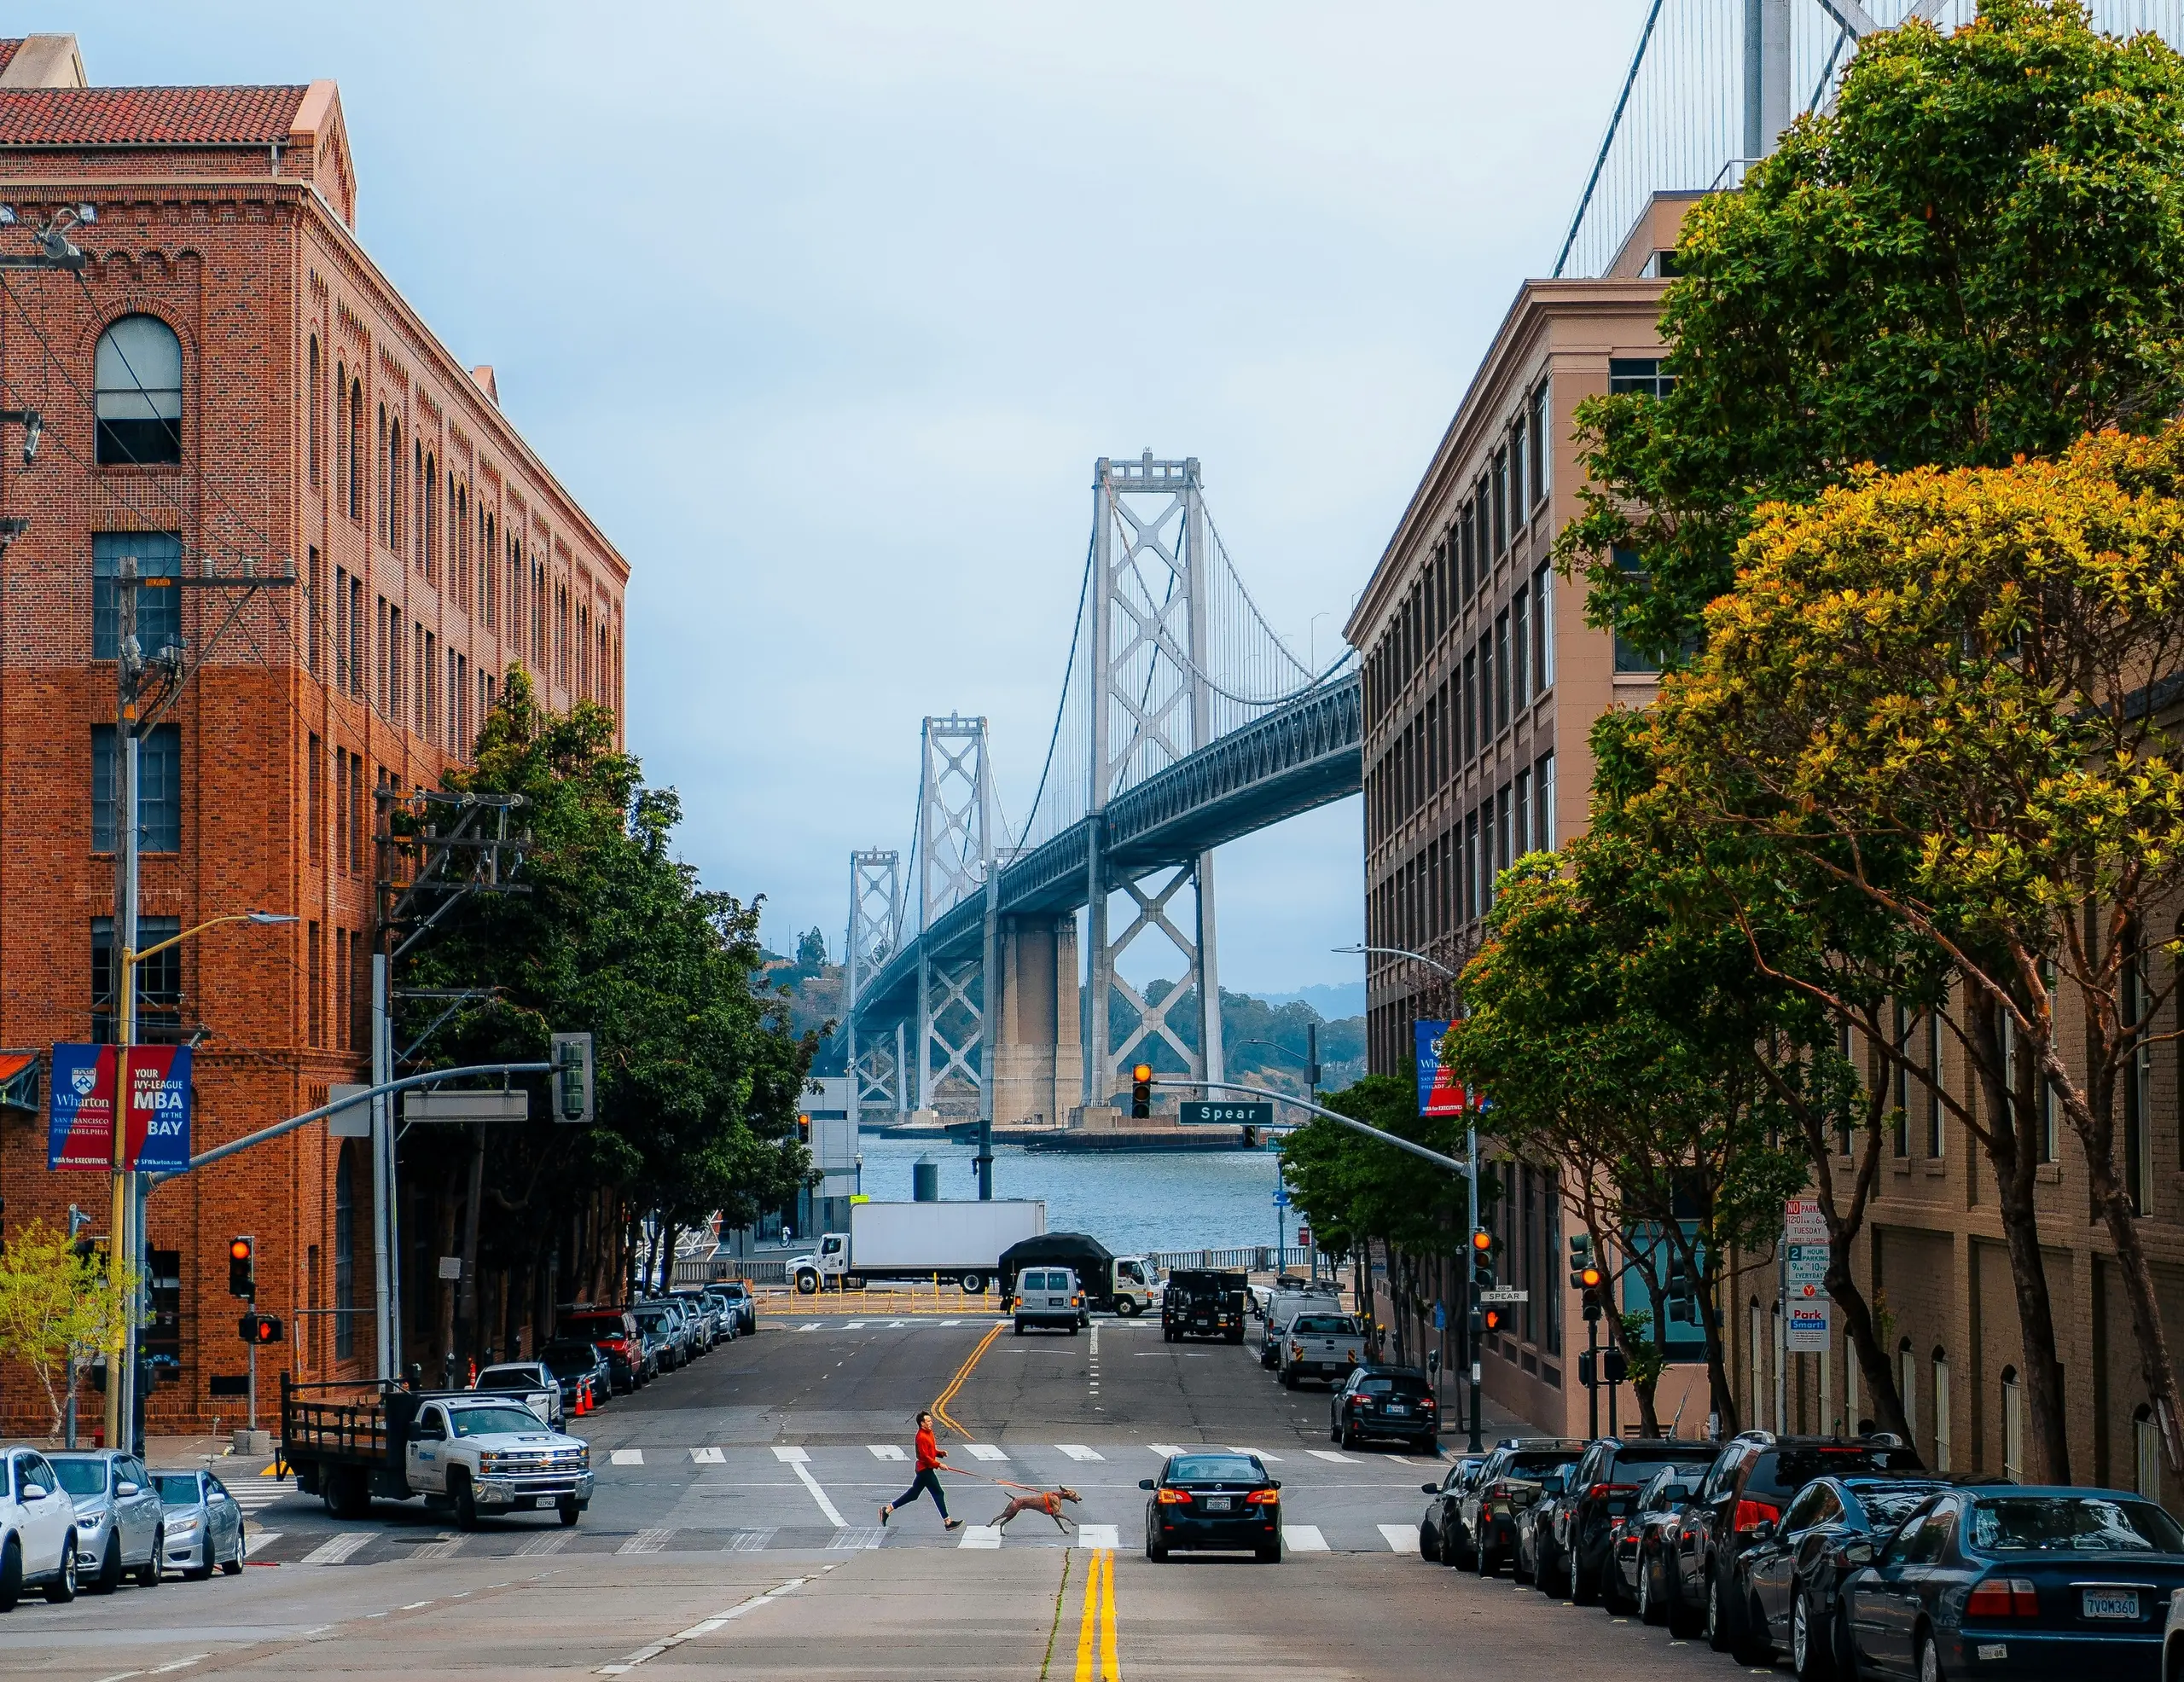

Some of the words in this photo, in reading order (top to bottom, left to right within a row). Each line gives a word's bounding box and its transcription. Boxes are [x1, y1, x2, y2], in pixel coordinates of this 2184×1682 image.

[134, 1069, 158, 1078] YOUR
[134, 1080, 183, 1089] IVY-LEAGUE
[55, 1093, 109, 1108] Wharton
[133, 1091, 183, 1109] MBA
[1200, 1107, 1255, 1121] Spear
[147, 1120, 183, 1135] BAY
[1787, 1203, 1798, 1213] NO
[1792, 1248, 1798, 1258] 2
[1794, 1309, 1821, 1319] Park
[2087, 1599, 2135, 1614] 7VQM360
